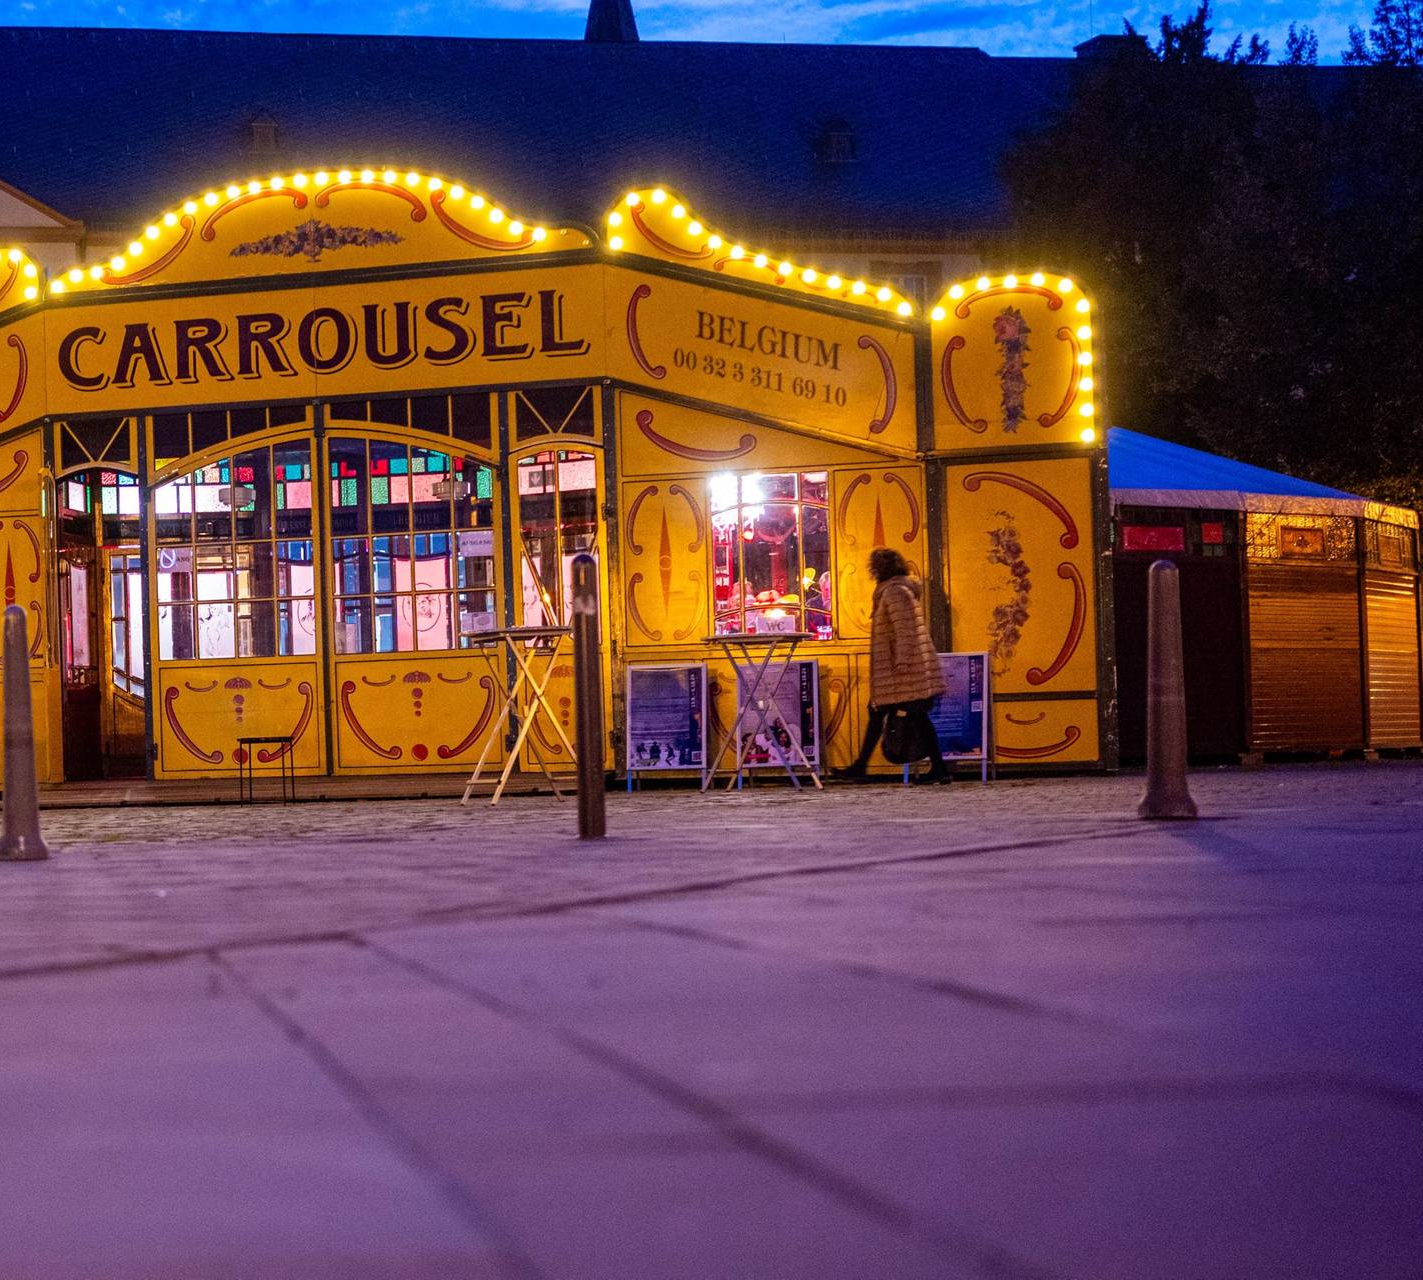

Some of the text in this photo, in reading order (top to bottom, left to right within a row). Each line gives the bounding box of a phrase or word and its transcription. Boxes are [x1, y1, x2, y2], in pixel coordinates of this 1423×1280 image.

[58, 289, 591, 392] CARROUSEL
[695, 310, 842, 371] BELGIUM
[673, 347, 848, 407] 00 32 3 311 69 10
[765, 621, 785, 632] WC
